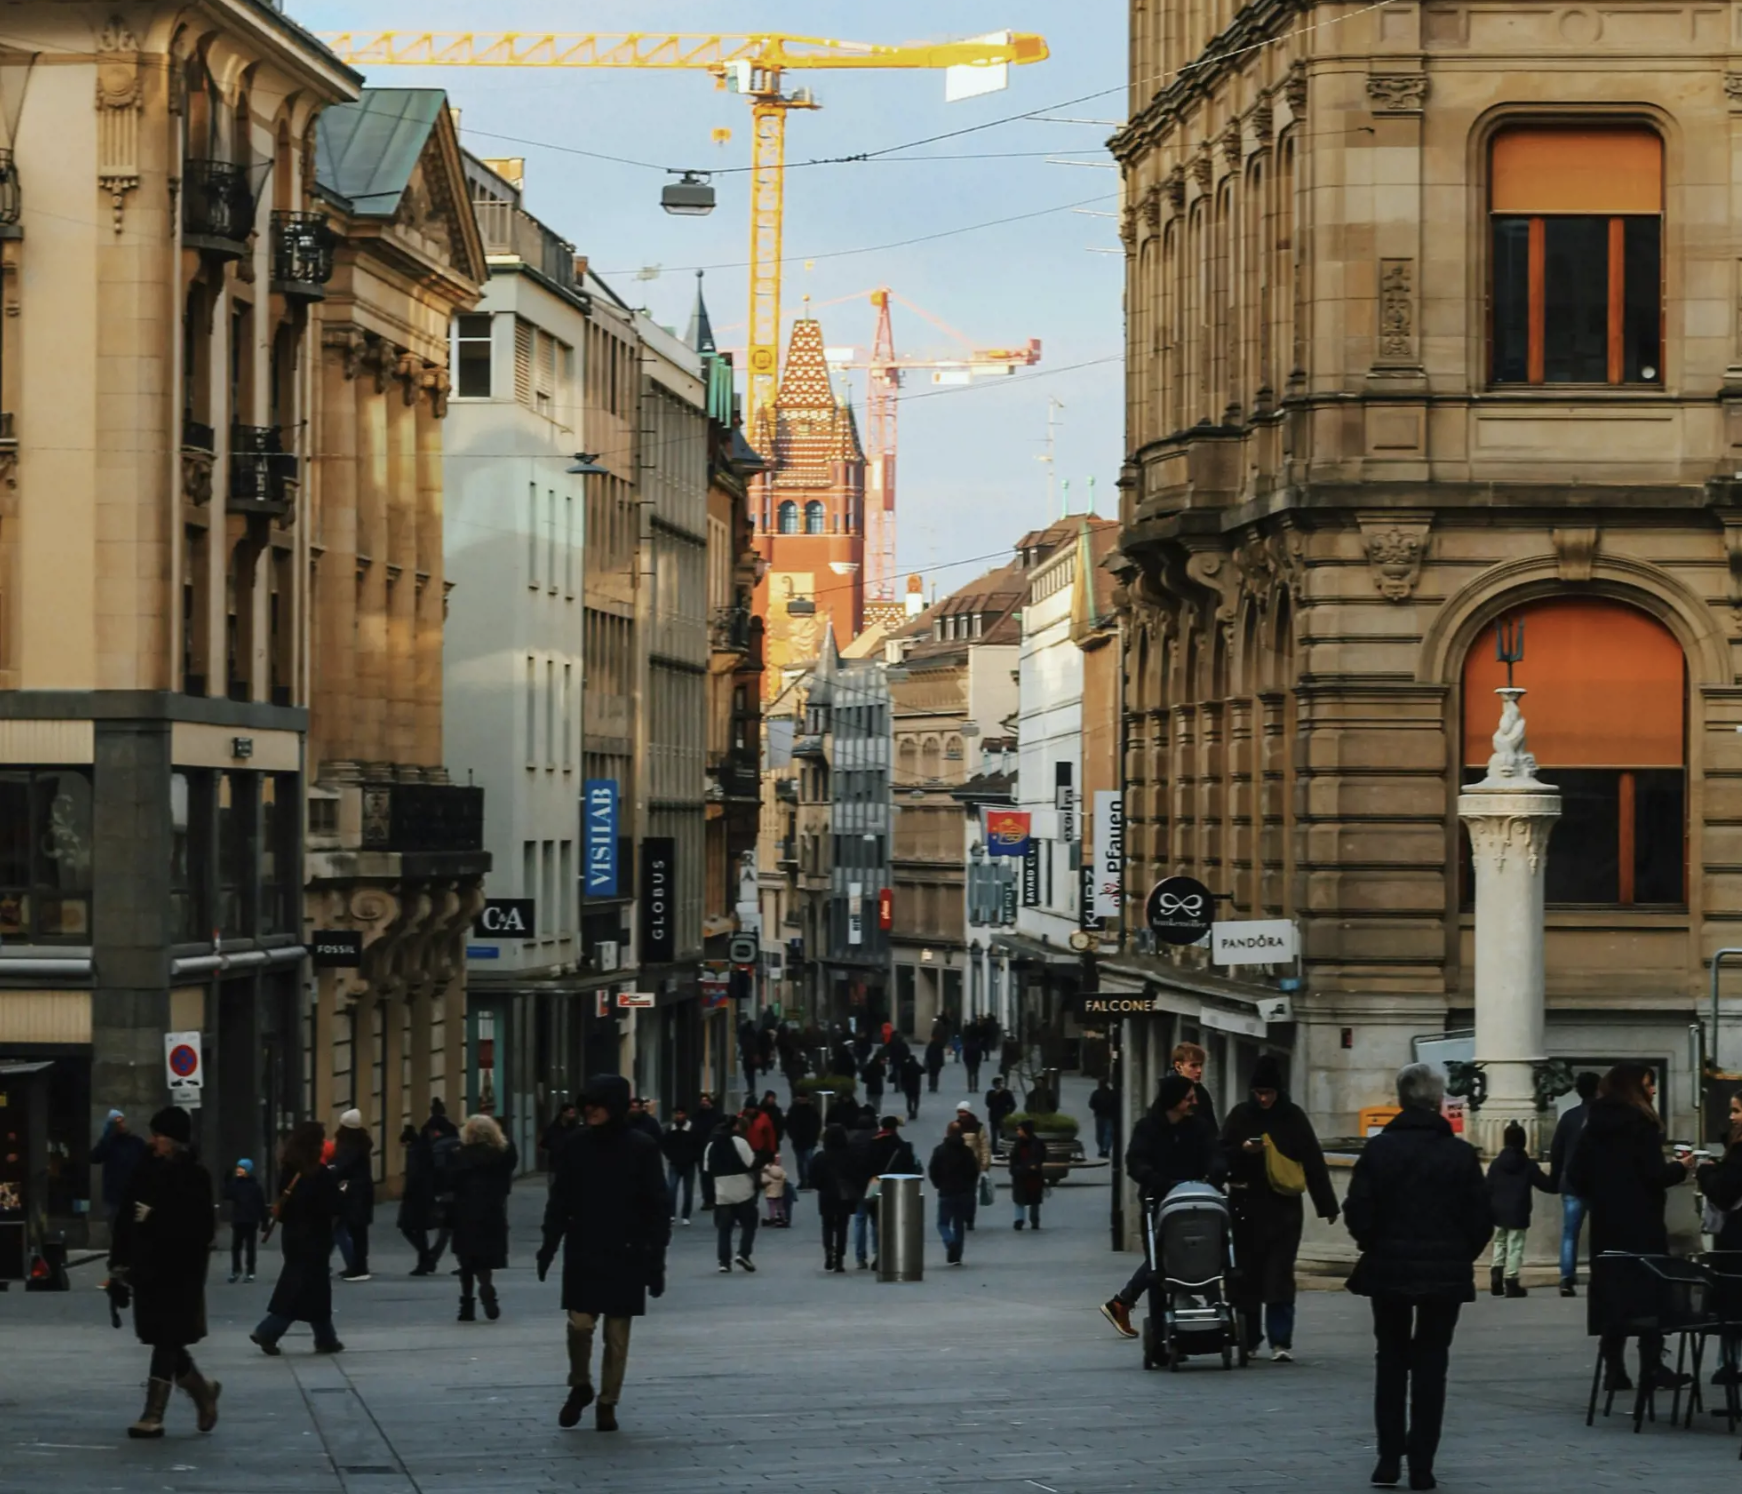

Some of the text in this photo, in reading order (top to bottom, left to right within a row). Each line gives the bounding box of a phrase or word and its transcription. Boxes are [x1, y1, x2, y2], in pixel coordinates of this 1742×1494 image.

[590, 788, 612, 887] VISILAB
[1105, 800, 1122, 873] Pfauen
[652, 860, 665, 940] GLOBUS
[1026, 869, 1035, 903] BAYARD
[482, 906, 526, 931] C&A
[316, 944, 356, 954] FOSSIL
[1221, 935, 1285, 949] PANDORA
